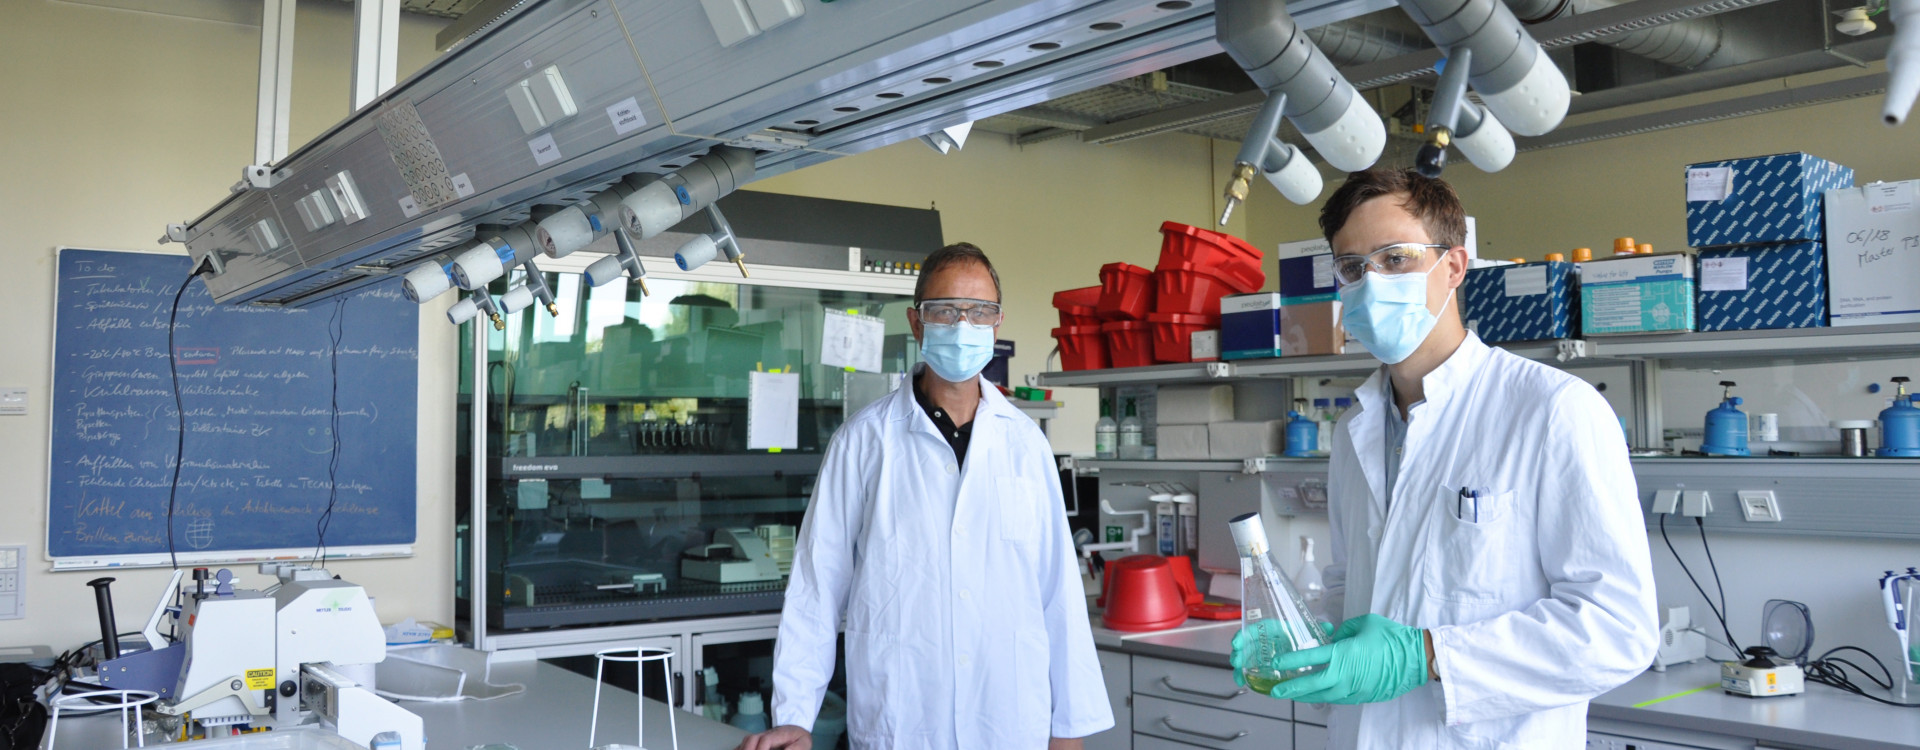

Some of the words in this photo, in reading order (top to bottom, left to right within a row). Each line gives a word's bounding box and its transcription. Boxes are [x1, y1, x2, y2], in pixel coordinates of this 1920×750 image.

[86, 318, 132, 333] Abfälle
[165, 455, 269, 471] Vebrauchsmaterialien
[77, 490, 124, 518] Kittel
[162, 500, 212, 518] Shluss
